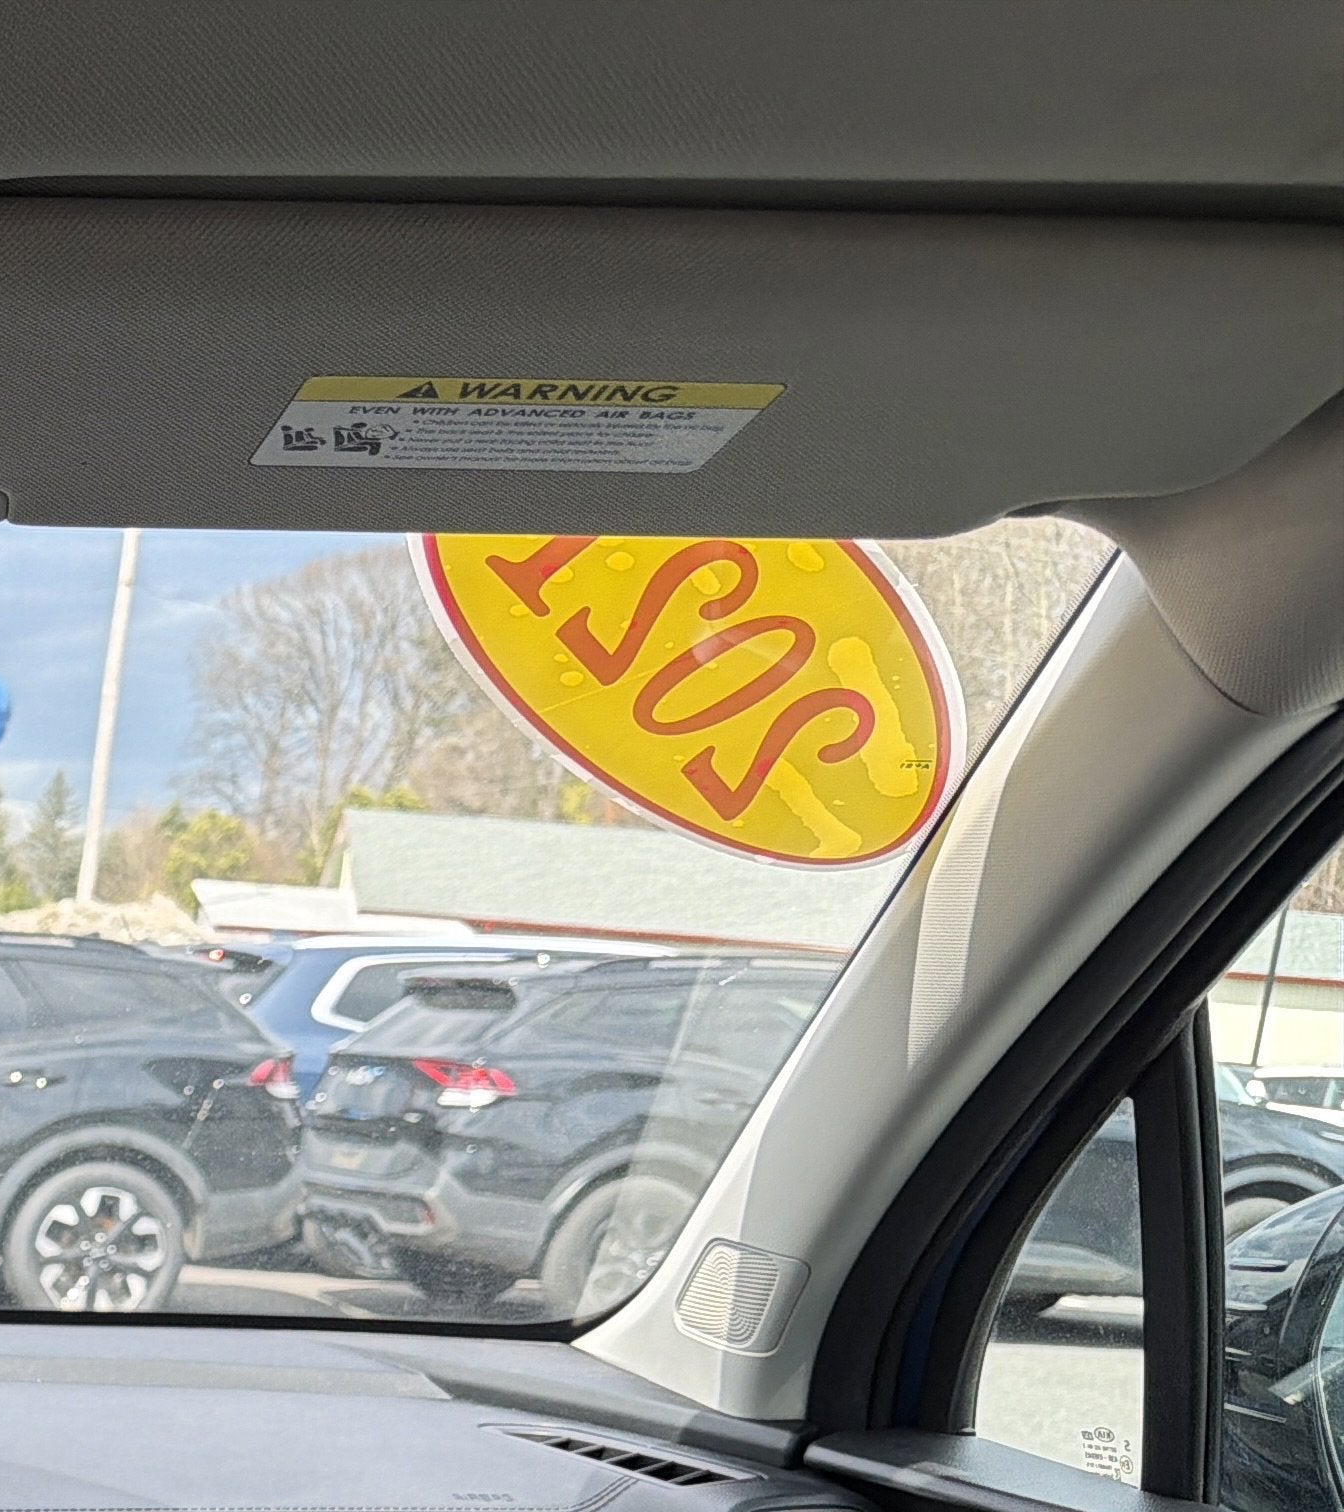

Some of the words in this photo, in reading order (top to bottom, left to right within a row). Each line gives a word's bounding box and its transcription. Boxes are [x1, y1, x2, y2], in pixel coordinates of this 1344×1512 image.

[459, 381, 680, 402] WARNING
[348, 406, 401, 415] EVEN
[412, 407, 460, 416] WITH
[467, 408, 586, 418] ADVANCED
[595, 410, 630, 419] AIR
[638, 411, 697, 420] BAGS
